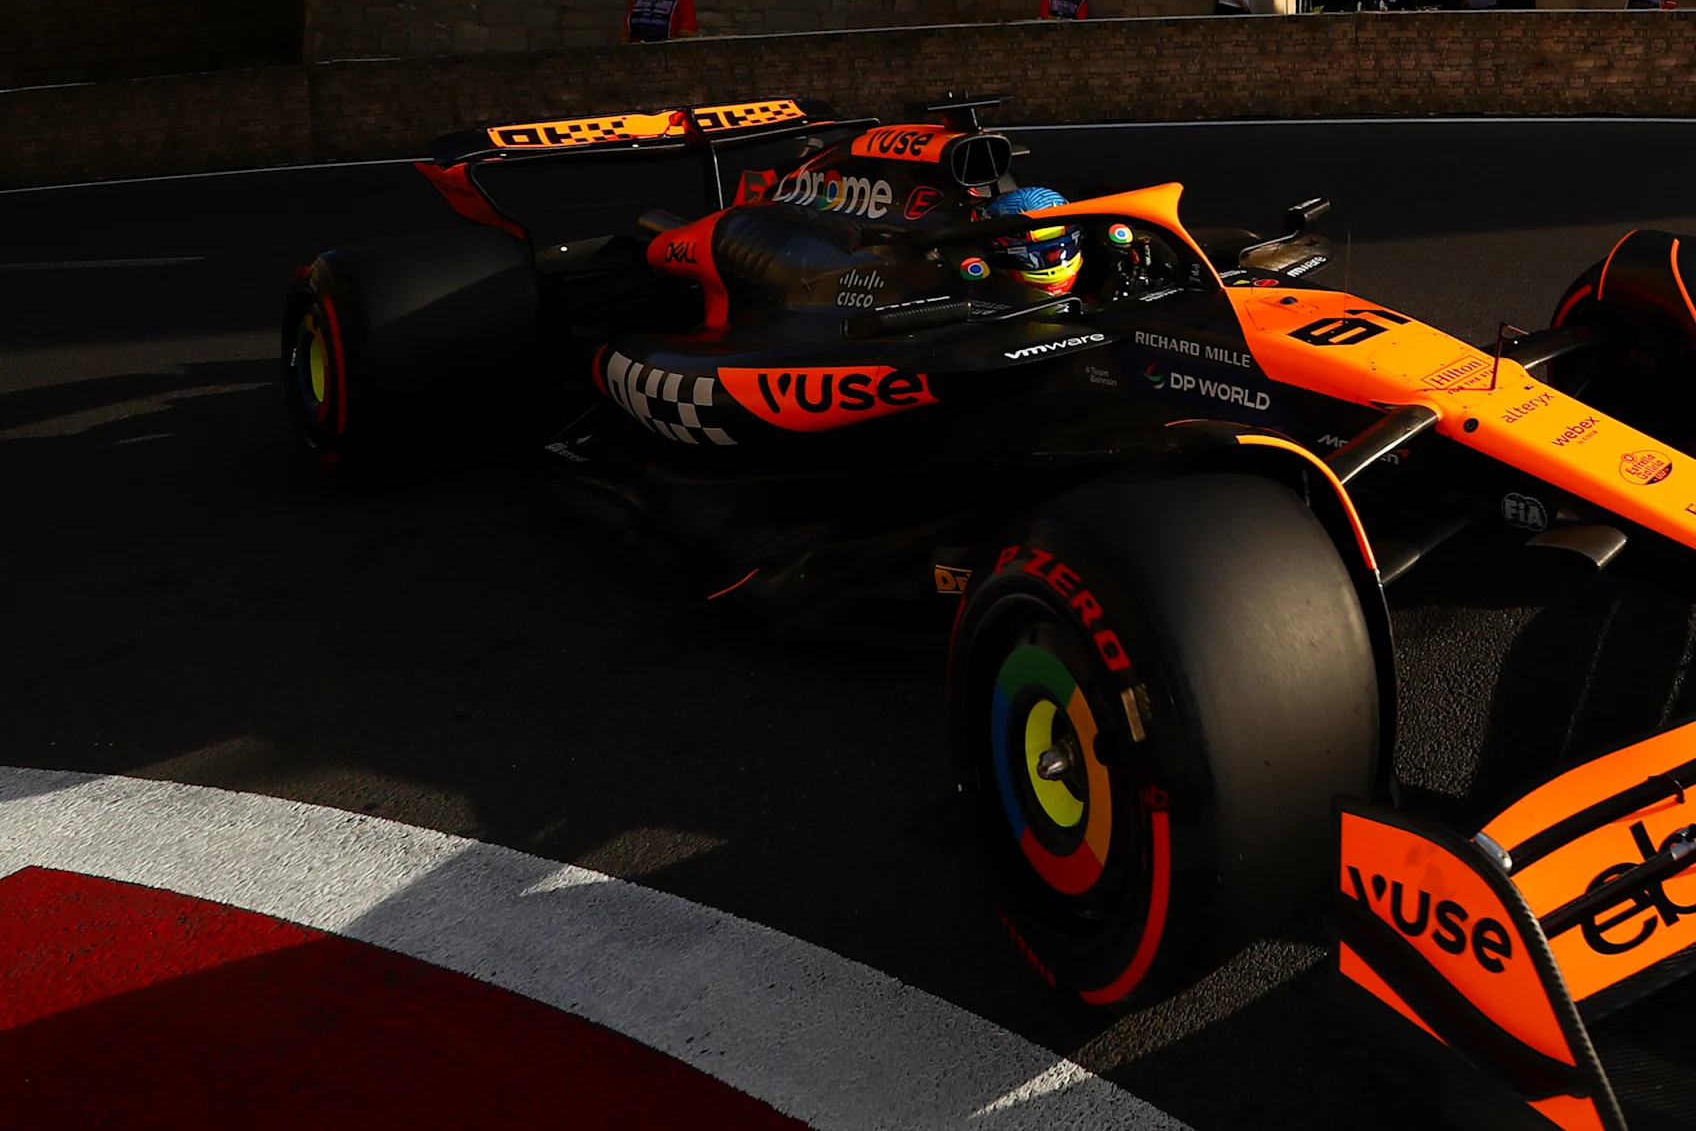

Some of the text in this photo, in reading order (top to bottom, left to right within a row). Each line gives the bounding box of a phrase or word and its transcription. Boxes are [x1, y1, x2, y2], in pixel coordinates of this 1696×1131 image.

[664, 241, 698, 264] DELL
[1003, 332, 1107, 360] vmware
[1134, 330, 1251, 369] RICHARD MILLE
[1429, 360, 1483, 386] Hilton
[1169, 371, 1272, 412] DP WORLD
[1500, 390, 1556, 425] alteryx
[1550, 415, 1601, 447] webex
[1625, 453, 1656, 476] Estrella
[1636, 460, 1666, 481] Galicia
[1021, 546, 1133, 673] ZERO
